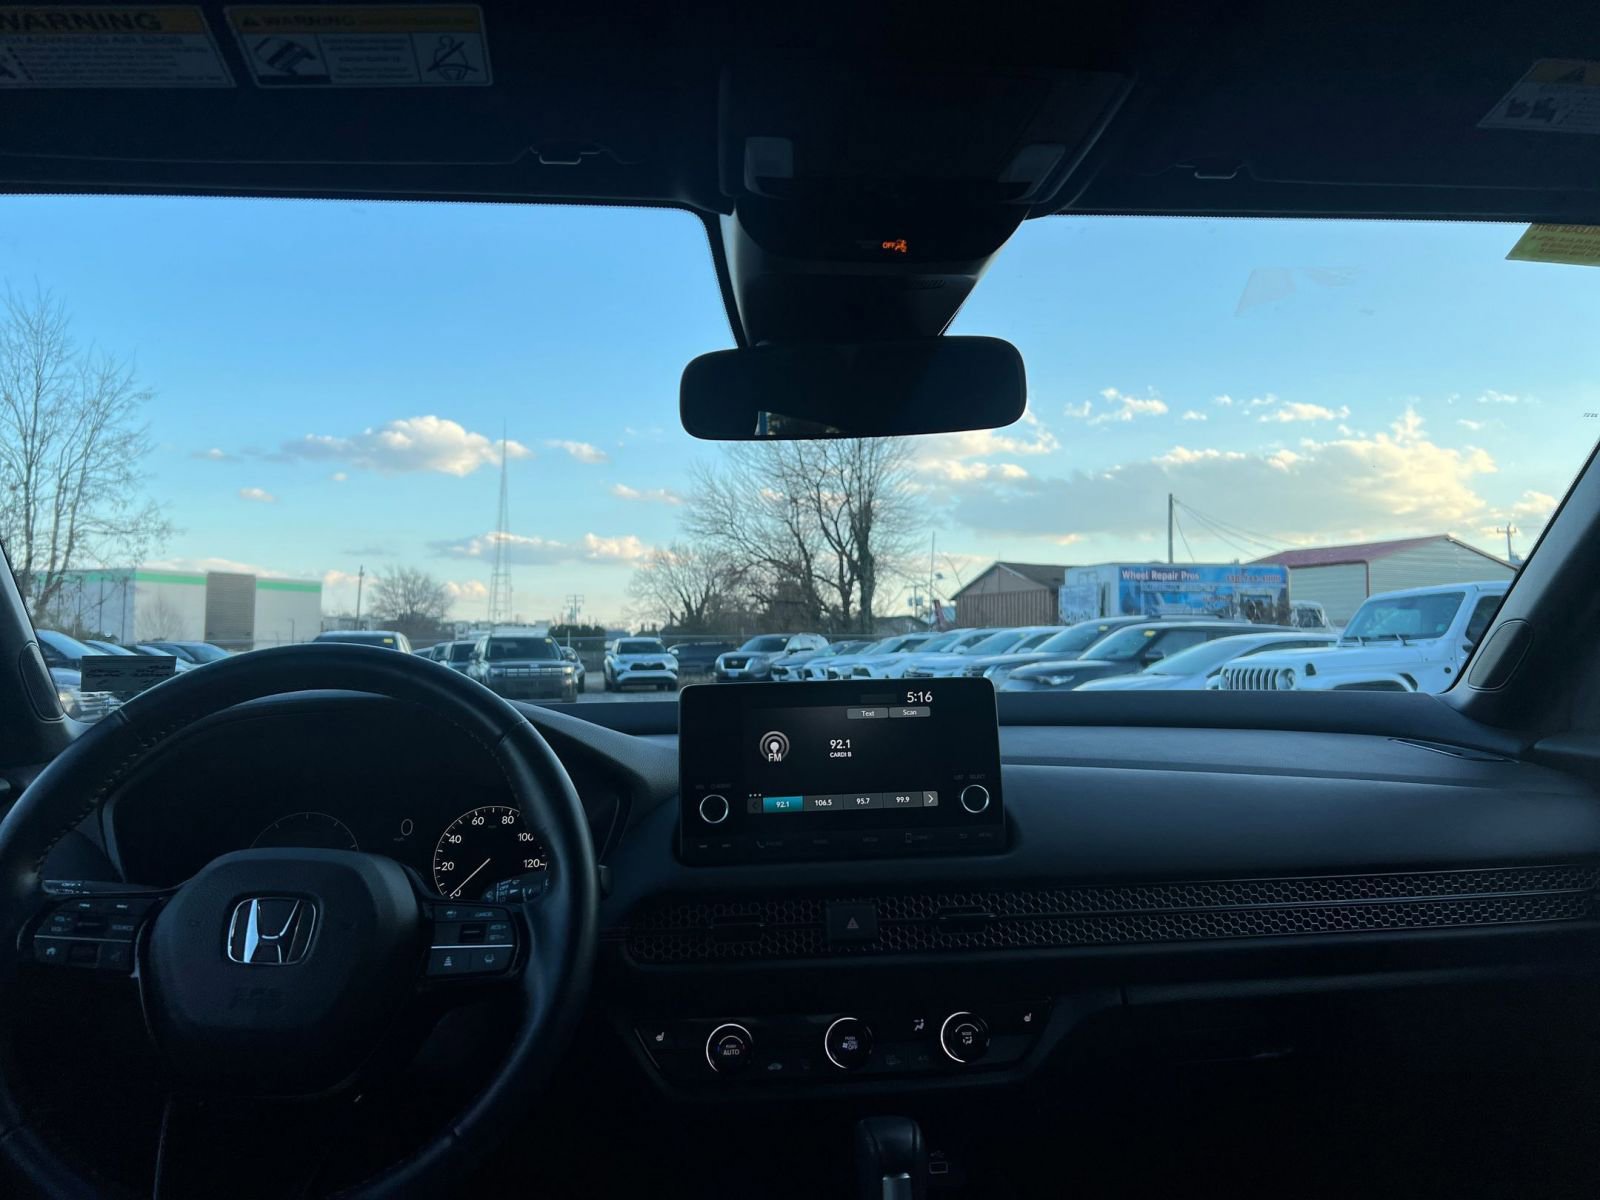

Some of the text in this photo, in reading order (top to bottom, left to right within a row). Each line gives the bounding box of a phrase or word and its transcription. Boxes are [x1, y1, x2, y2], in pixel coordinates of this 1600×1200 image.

[882, 241, 896, 249] OFF
[1122, 570, 1200, 583] Wheel Repair Pros
[906, 691, 933, 703] 5:16
[829, 739, 851, 749] 92.1
[768, 753, 782, 762] FM
[814, 799, 832, 807] 106.5
[856, 797, 871, 805] 95.7
[895, 796, 910, 804] 99.9
[471, 816, 485, 826] 60
[501, 815, 515, 825] 80
[400, 818, 413, 836] 0
[448, 834, 462, 844] 40
[517, 832, 534, 842] 100
[441, 861, 455, 871] 20
[522, 858, 540, 868] 120
[723, 1048, 740, 1056] AUTO
